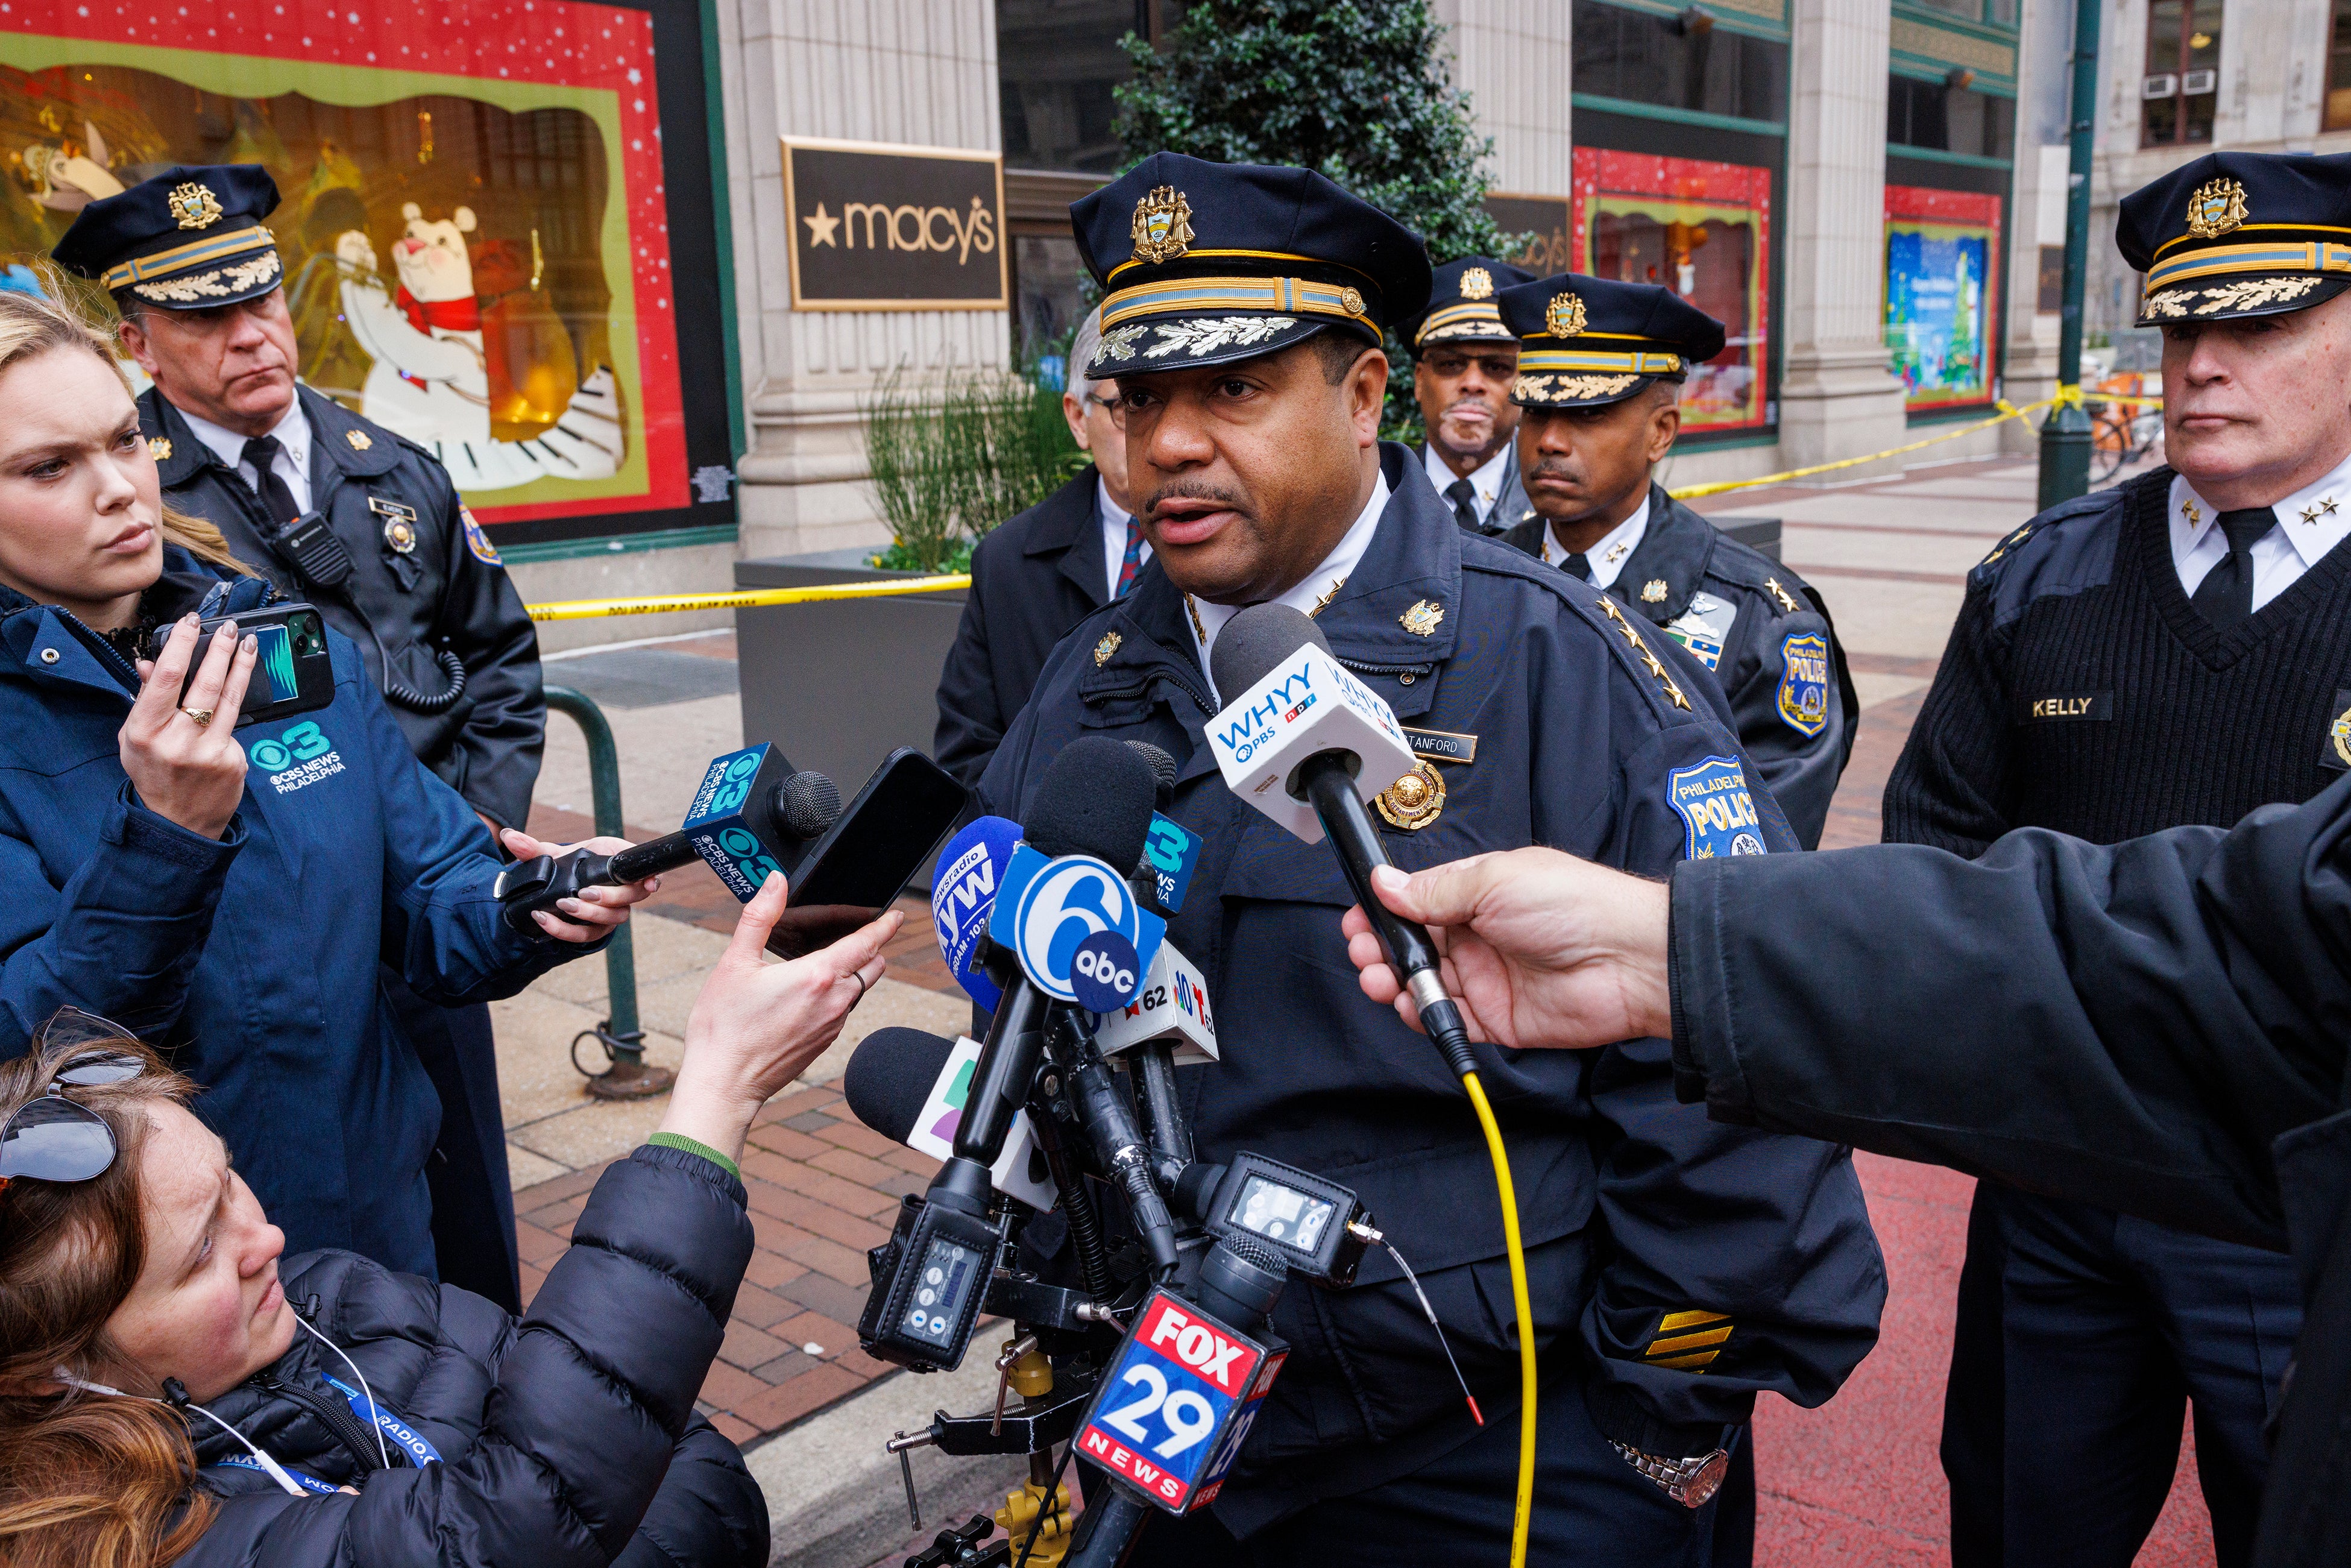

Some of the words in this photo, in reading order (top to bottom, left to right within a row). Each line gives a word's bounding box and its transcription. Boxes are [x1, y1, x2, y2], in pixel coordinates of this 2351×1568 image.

[845, 195, 995, 266] macy's
[1217, 662, 1311, 749] WHYY
[1286, 694, 1315, 722] npr
[1324, 661, 1394, 727] WHYY
[2033, 697, 2092, 717] KELLY
[282, 720, 330, 760] 3
[1252, 726, 1276, 749] PBS
[275, 762, 346, 794] PHILADELPHIA
[279, 767, 304, 782] CBS
[303, 751, 341, 773] NEWS
[687, 763, 720, 822] PHILADELPHIA
[696, 788, 717, 819] NEWS
[1390, 802, 1423, 817] DEPARTMENT
[691, 838, 743, 896] PHILADELPHIA
[724, 860, 755, 893] NEWS
[934, 852, 978, 908] newsradio
[1025, 864, 1122, 993] 6
[1076, 949, 1135, 993] abc
[1176, 970, 1193, 1016] 10
[1143, 986, 1168, 1011] 62
[1150, 1307, 1244, 1387] FOX
[1101, 1364, 1215, 1459] 29
[1087, 1432, 1179, 1498] NEWS
[1192, 1484, 1221, 1505] NEWS
